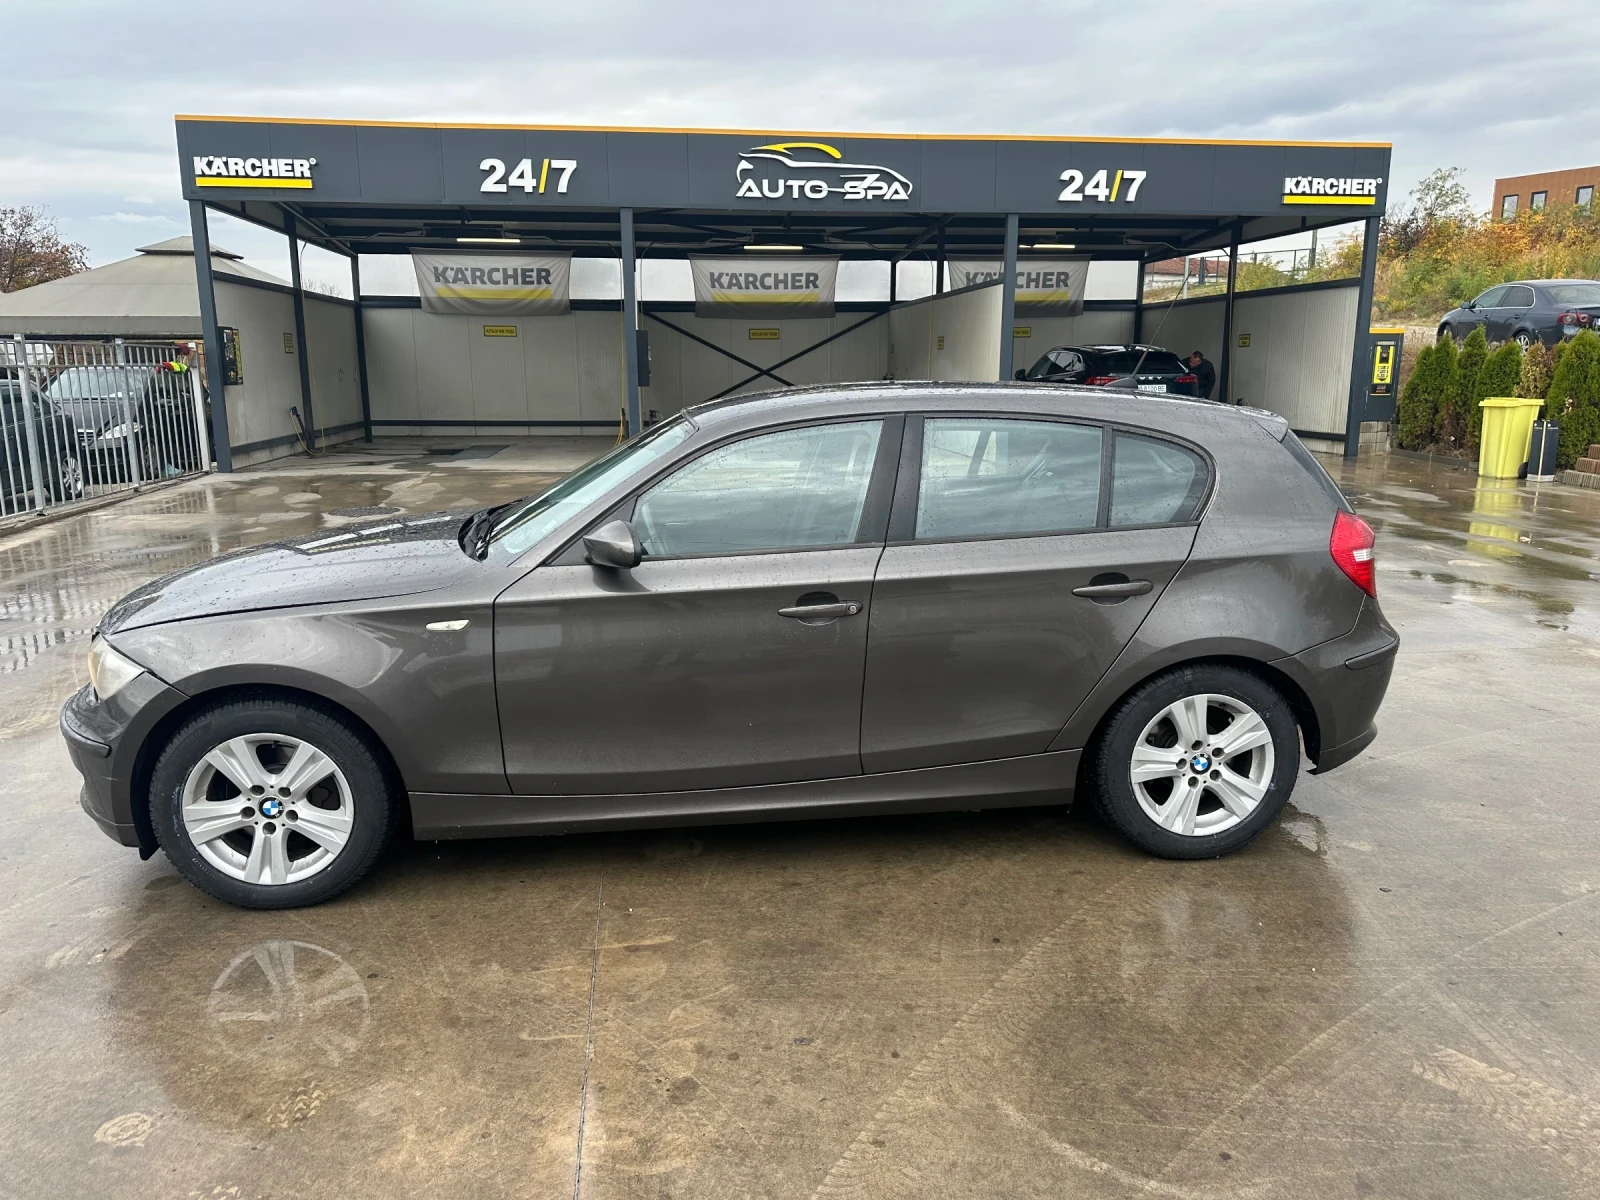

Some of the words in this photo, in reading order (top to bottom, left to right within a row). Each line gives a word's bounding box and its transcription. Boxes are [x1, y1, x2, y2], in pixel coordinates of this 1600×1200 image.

[479, 158, 577, 193] 24/7
[1058, 169, 1147, 202] 24/7
[736, 178, 828, 199] AUTO
[843, 175, 909, 200] SPA
[433, 266, 552, 285] KÄRCHER
[709, 271, 819, 290] KÄRCHER
[965, 271, 1070, 289] KÄCHER
